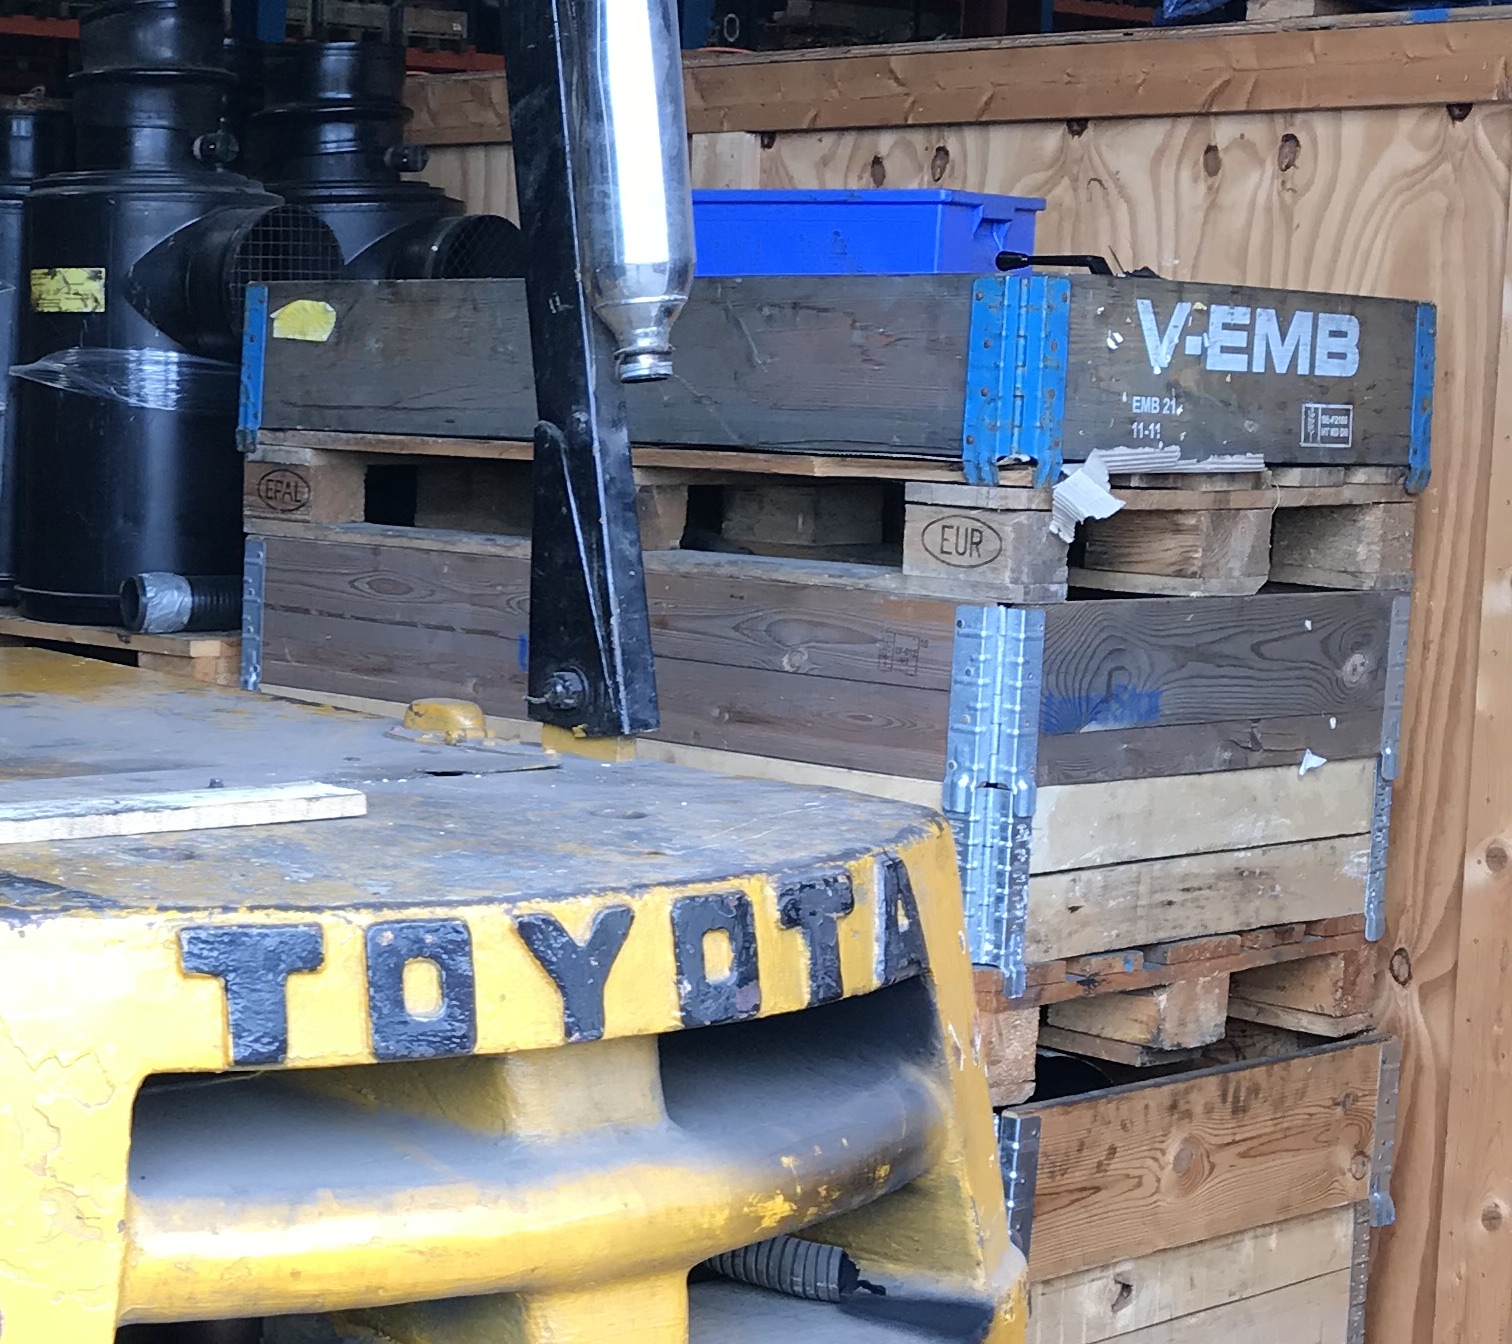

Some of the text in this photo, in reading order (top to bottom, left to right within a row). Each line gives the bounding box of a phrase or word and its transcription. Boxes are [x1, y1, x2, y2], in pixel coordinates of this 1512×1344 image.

[1135, 298, 1361, 378] V-EMB
[1132, 396, 1160, 414] EMB
[265, 479, 301, 503] EPAL
[939, 524, 984, 558] EUR
[178, 854, 931, 1066] TOYOTA
